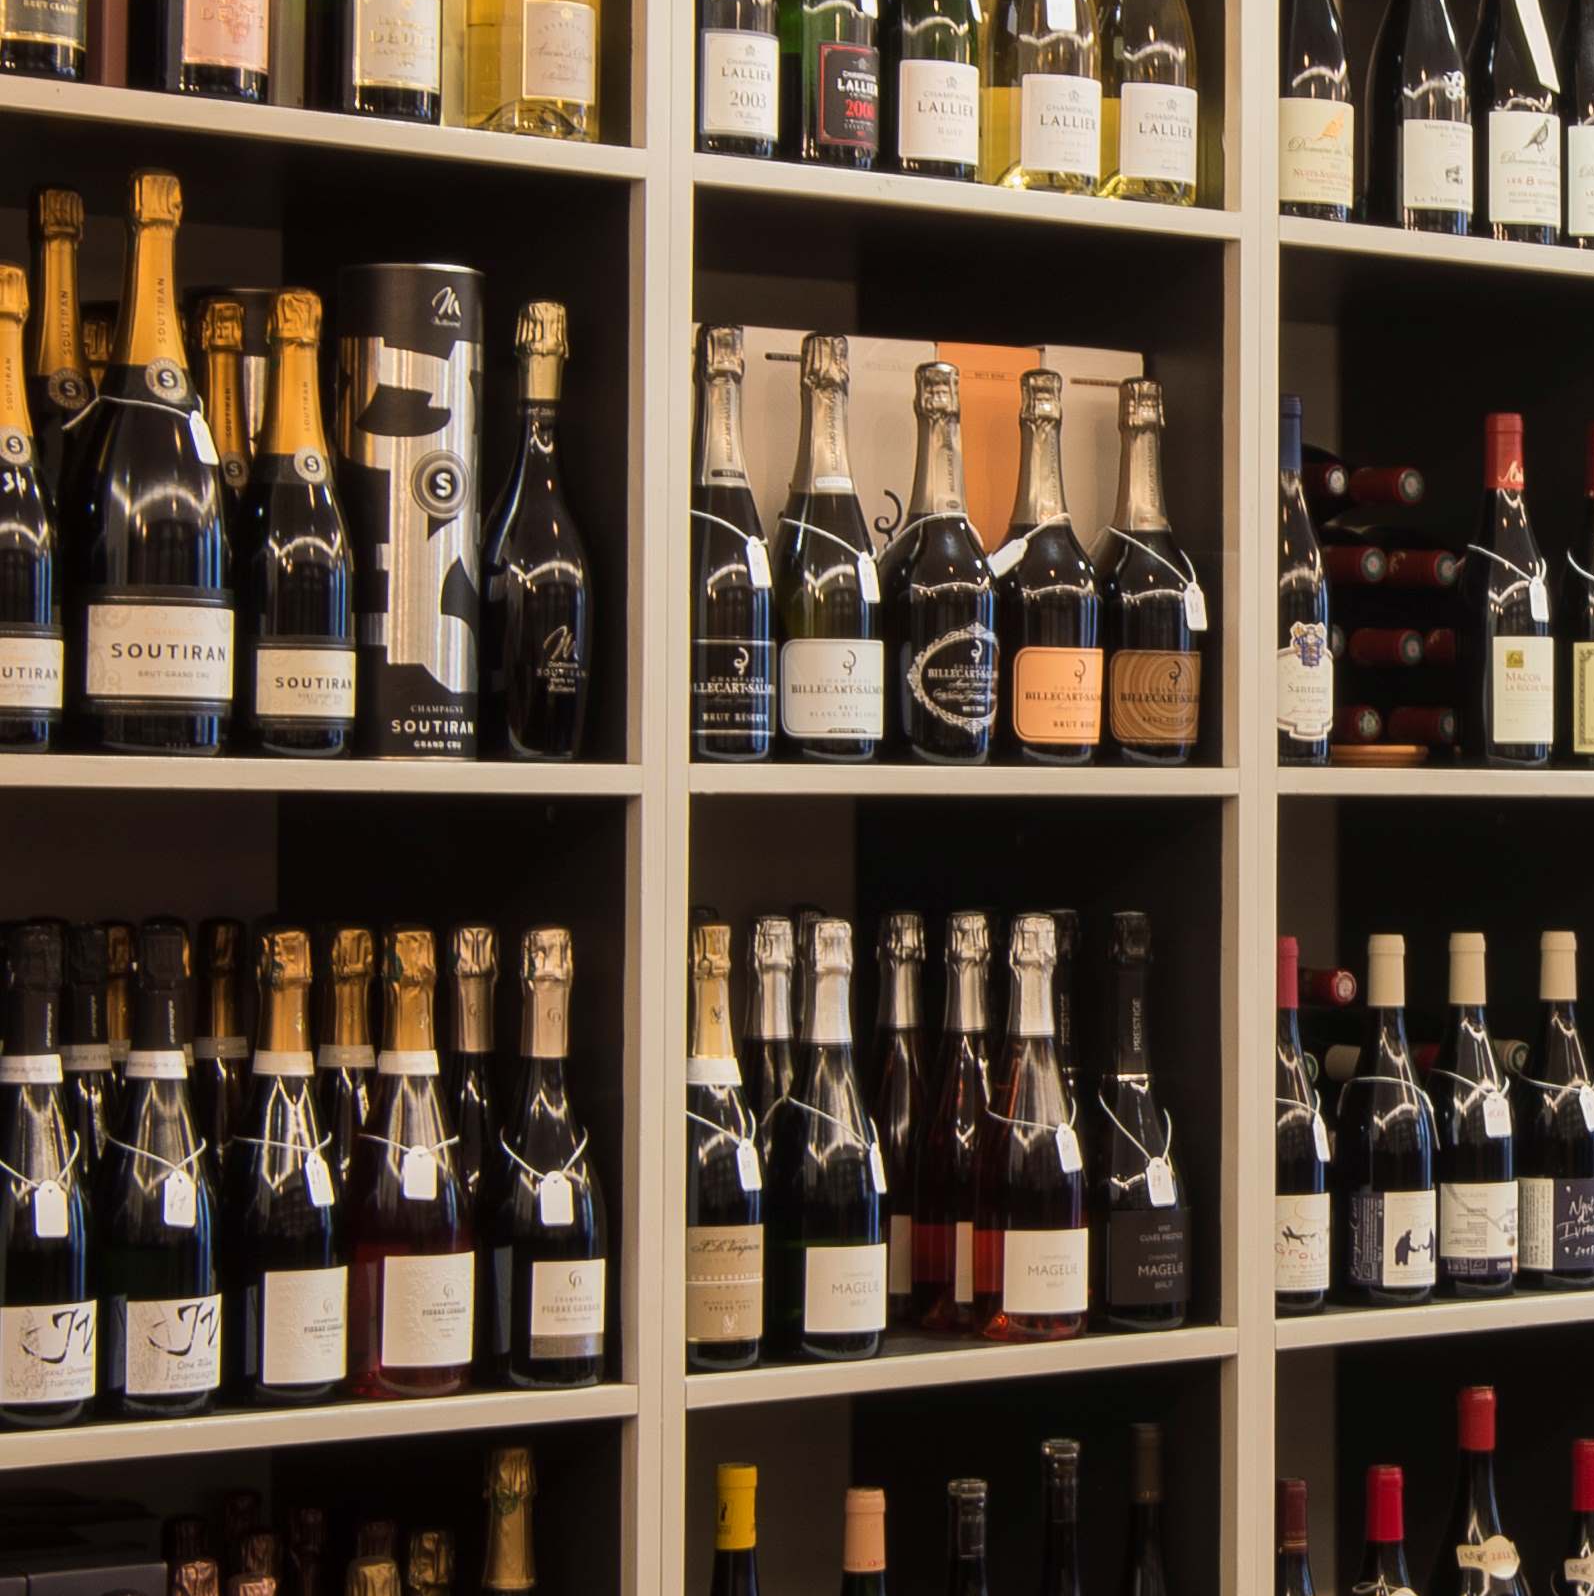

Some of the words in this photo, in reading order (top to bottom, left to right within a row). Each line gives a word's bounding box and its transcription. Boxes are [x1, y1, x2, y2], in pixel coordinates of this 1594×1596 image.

[721, 67, 772, 81] LALLIER
[729, 90, 767, 109] 2003
[917, 99, 975, 118] LALLIER
[1039, 113, 1096, 131] LALLIER
[1139, 122, 1193, 140] LALLIER
[1526, 174, 1535, 186] 8
[156, 277, 167, 344] SOUTIRAN
[61, 289, 73, 356] SOUTIRAN
[161, 370, 175, 386] S
[303, 380, 312, 433] SOUTIRAN
[9, 438, 21, 452] S
[306, 457, 318, 471] S
[436, 472, 453, 495] S
[111, 642, 227, 661] SOUTIRAN
[138, 669, 162, 679] BRUT
[164, 670, 193, 680] GRAND
[275, 675, 352, 690] SOUTIRAN
[410, 705, 464, 715] CHAMPAGNE
[703, 713, 730, 721] BRUT
[391, 718, 474, 735] SOUTIRAN
[413, 739, 444, 749] GRAND
[446, 740, 462, 750] CRU
[1132, 998, 1142, 1052] PRESTIGE
